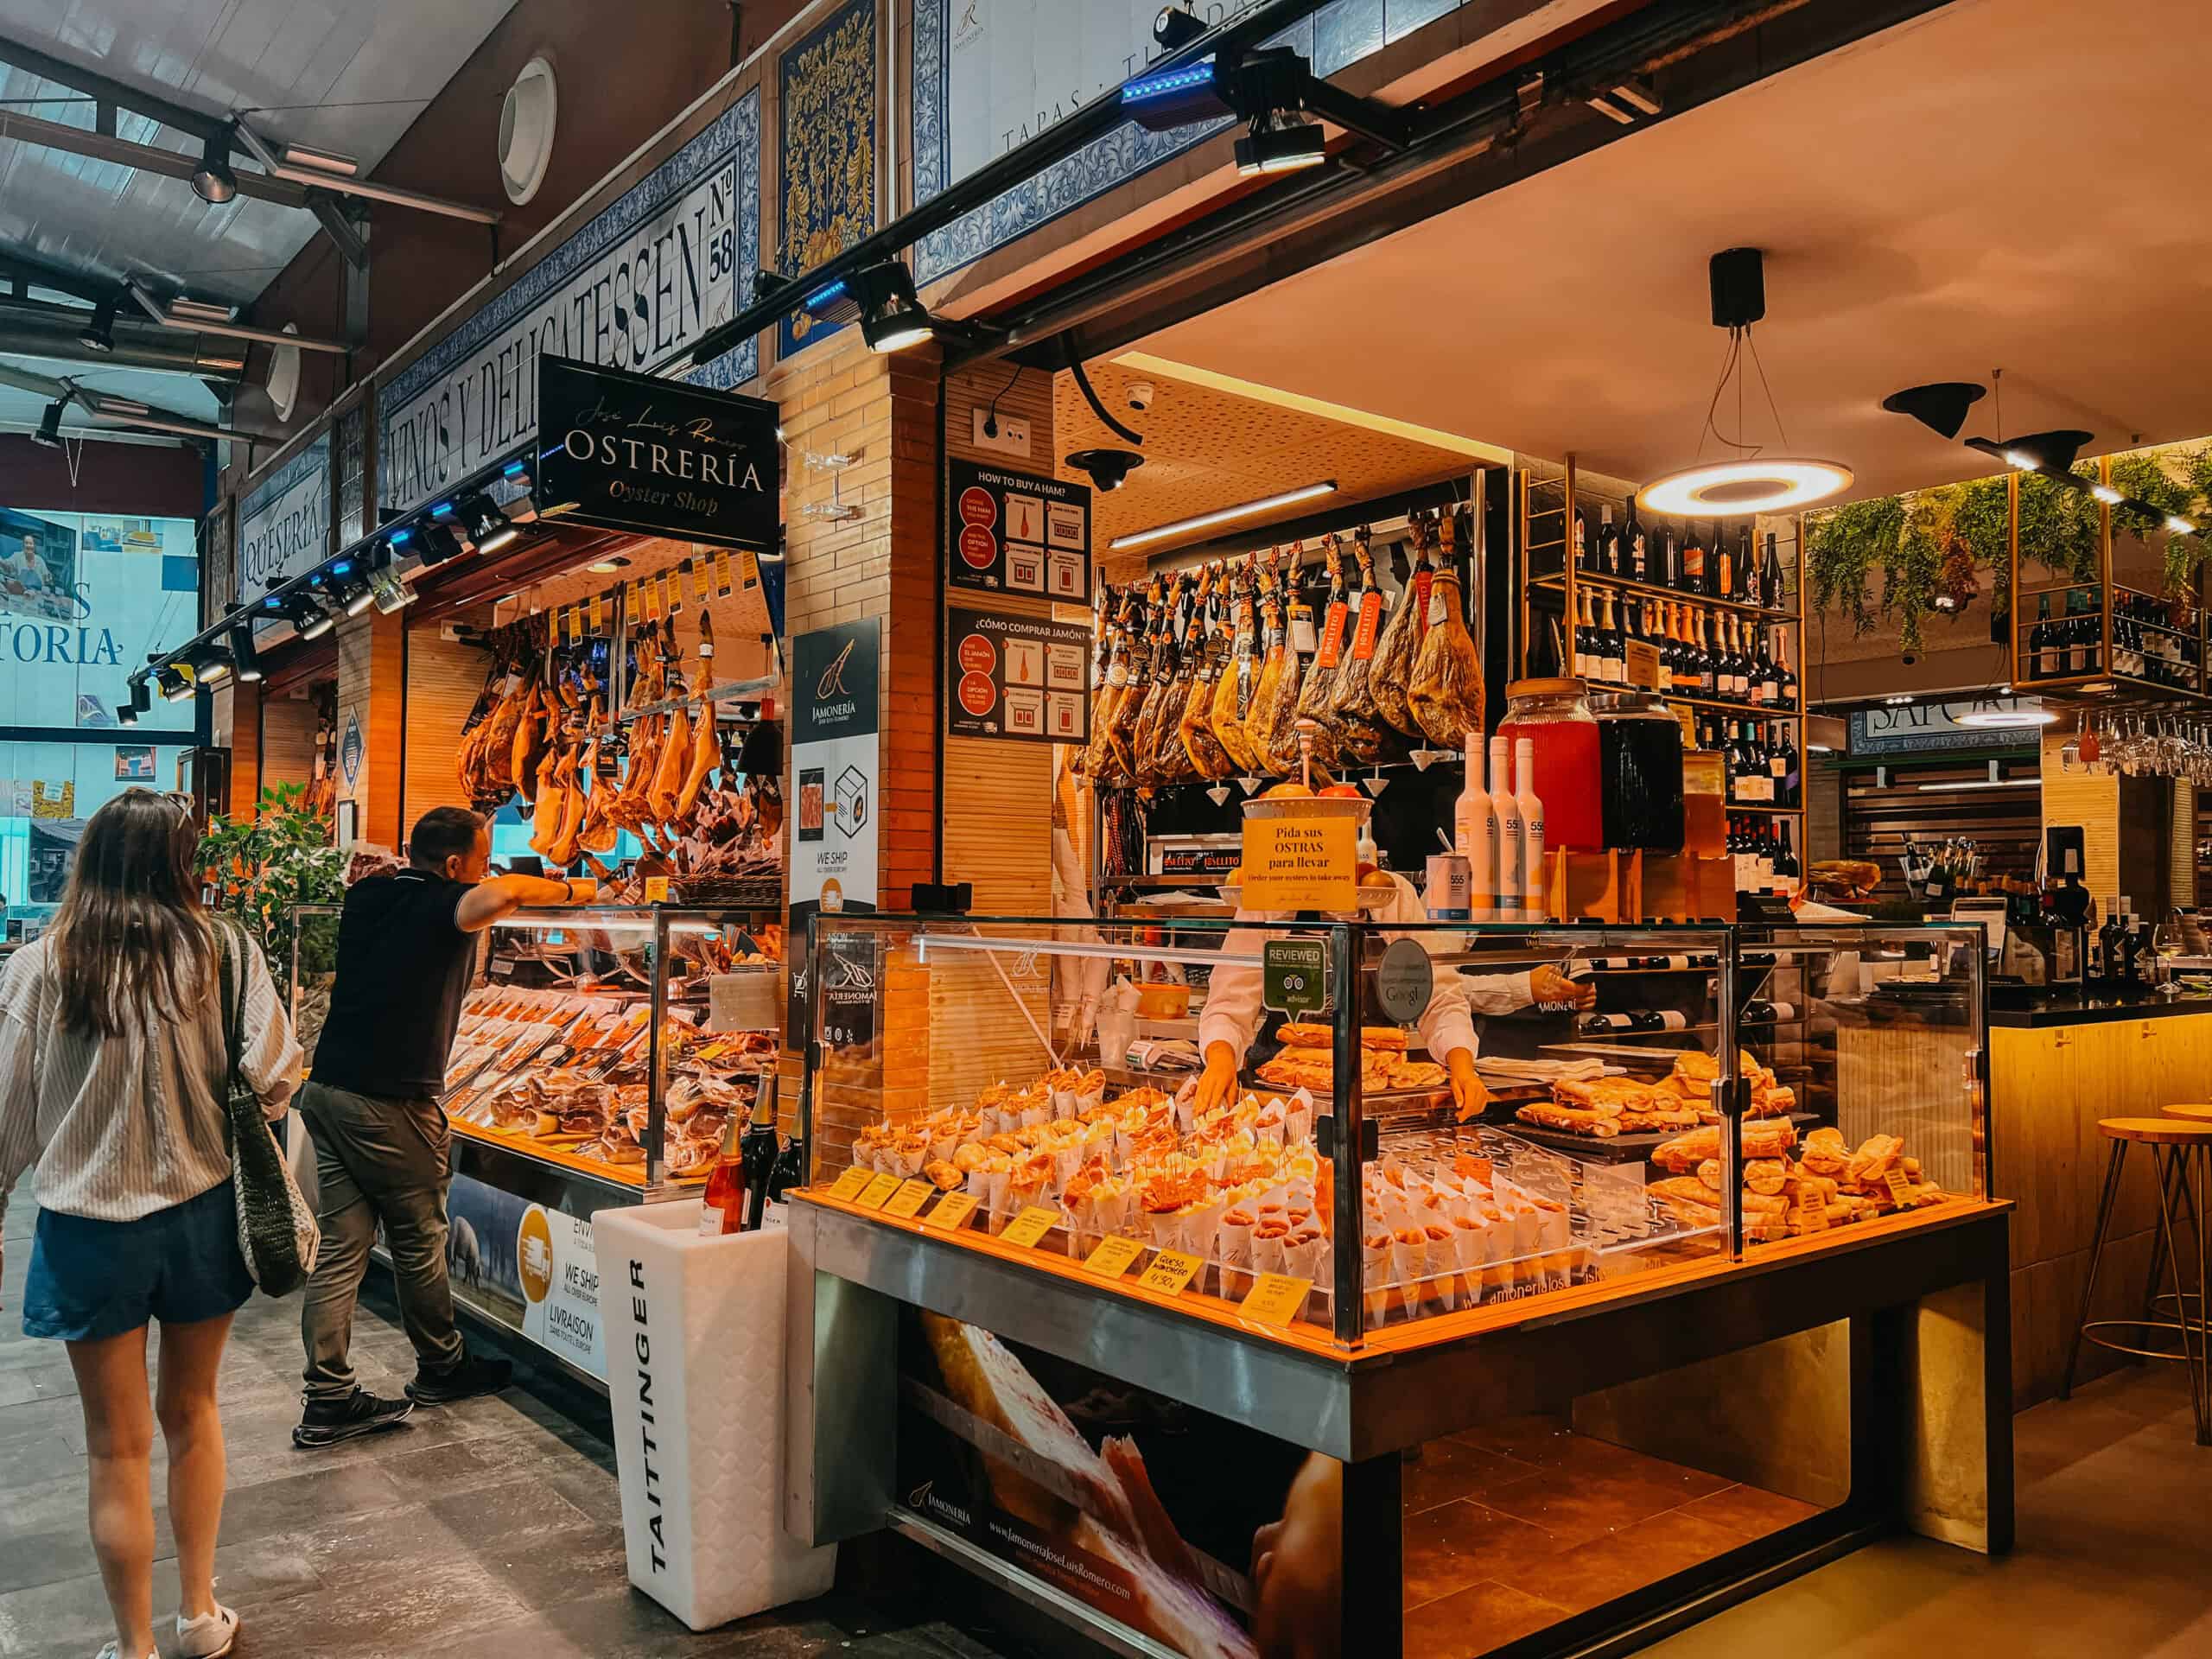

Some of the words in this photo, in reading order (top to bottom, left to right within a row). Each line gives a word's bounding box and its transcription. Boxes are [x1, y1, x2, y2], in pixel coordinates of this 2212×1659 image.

[710, 228, 733, 283] 58
[389, 389, 450, 509] VINOS
[458, 376, 478, 468] Y
[564, 429, 765, 493] OSTRERÍA
[978, 471, 1001, 484] HOW
[1002, 476, 1014, 486] TO
[1016, 479, 1034, 491] BUY
[1034, 482, 1041, 493] A
[1041, 485, 1065, 498] HAM?
[609, 480, 671, 505] Oyster
[674, 491, 720, 518] Shop
[245, 491, 320, 588] QUESERÍA
[976, 618, 1007, 631] ¿CÓMO
[1008, 623, 1051, 638] COMPRAR
[1052, 628, 1085, 641] JAMÓN?
[812, 700, 855, 722] JAMONERÍA
[1276, 826, 1300, 838] Pida
[1303, 829, 1323, 837] sus
[817, 851, 830, 865] WE
[830, 851, 848, 865] SHIP
[1274, 842, 1324, 853] OSTRAS
[1268, 859, 1294, 871] para
[1296, 855, 1330, 868] llevar
[1451, 874, 1464, 885] 555
[1269, 949, 1320, 962] REVIEWED
[565, 1262, 579, 1285] WE
[580, 1269, 599, 1293] SHIP
[550, 1302, 594, 1341] LIVRAISON
[629, 1258, 667, 1574] TAITTINGER
